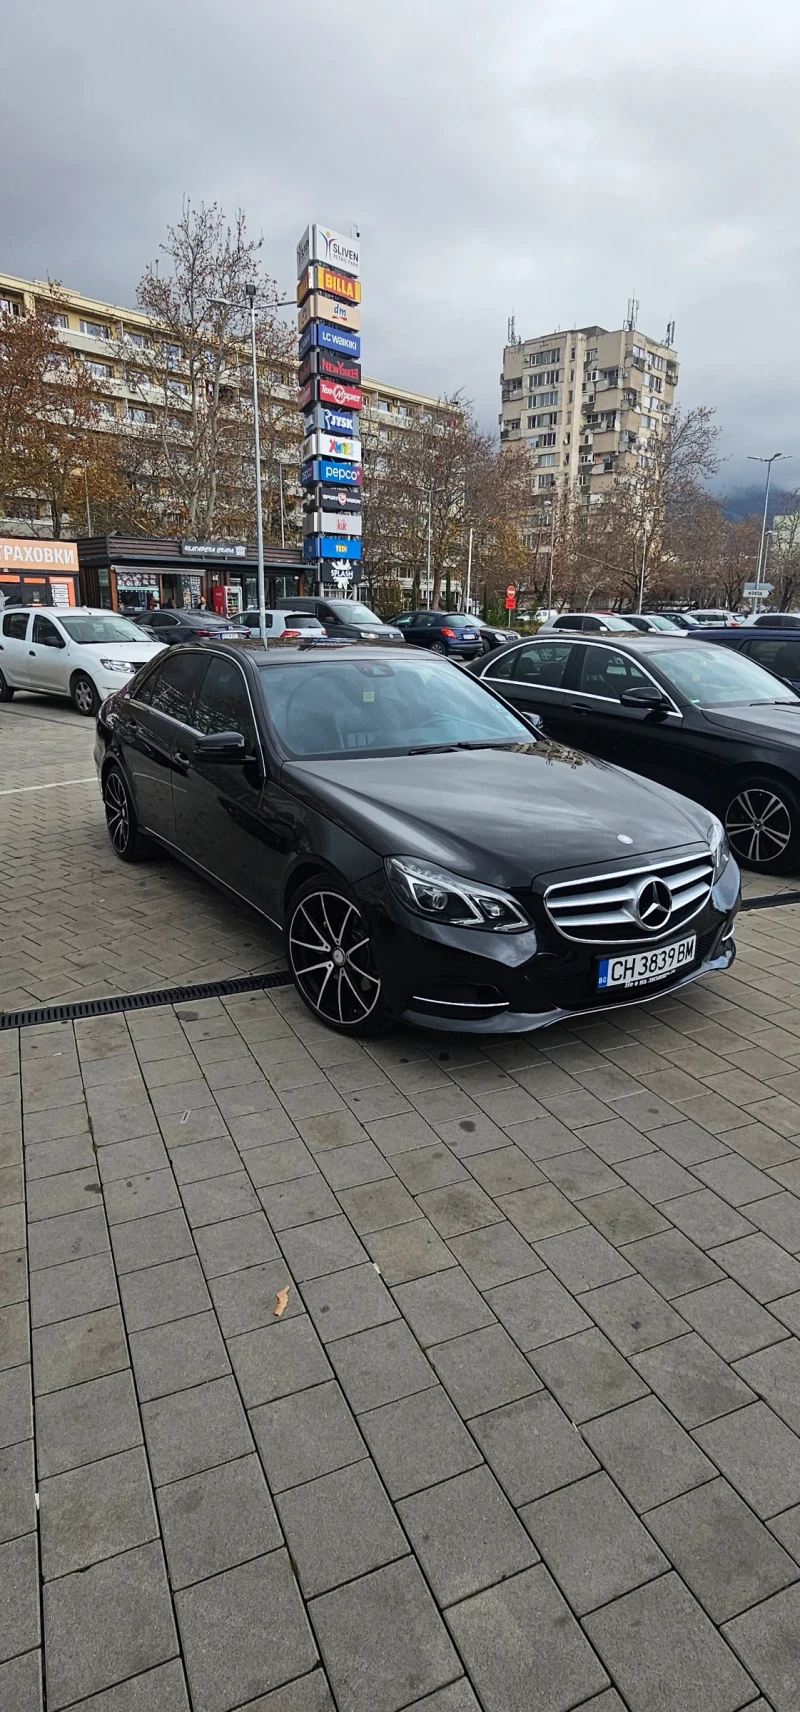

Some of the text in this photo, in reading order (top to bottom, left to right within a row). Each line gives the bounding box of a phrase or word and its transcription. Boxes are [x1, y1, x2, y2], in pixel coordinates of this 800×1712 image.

[333, 243, 358, 262] SLIVEN
[333, 254, 359, 268] RETAIL PARK
[325, 274, 353, 297] BILLA
[334, 304, 347, 317] dm
[322, 331, 332, 342] LC
[331, 415, 353, 429] JYSK
[325, 466, 357, 480] pepco
[330, 569, 354, 578] SPLASH
[611, 957, 636, 982] CH
[638, 947, 675, 976] 3839
[677, 939, 694, 964] BM
[598, 976, 608, 984] BG
